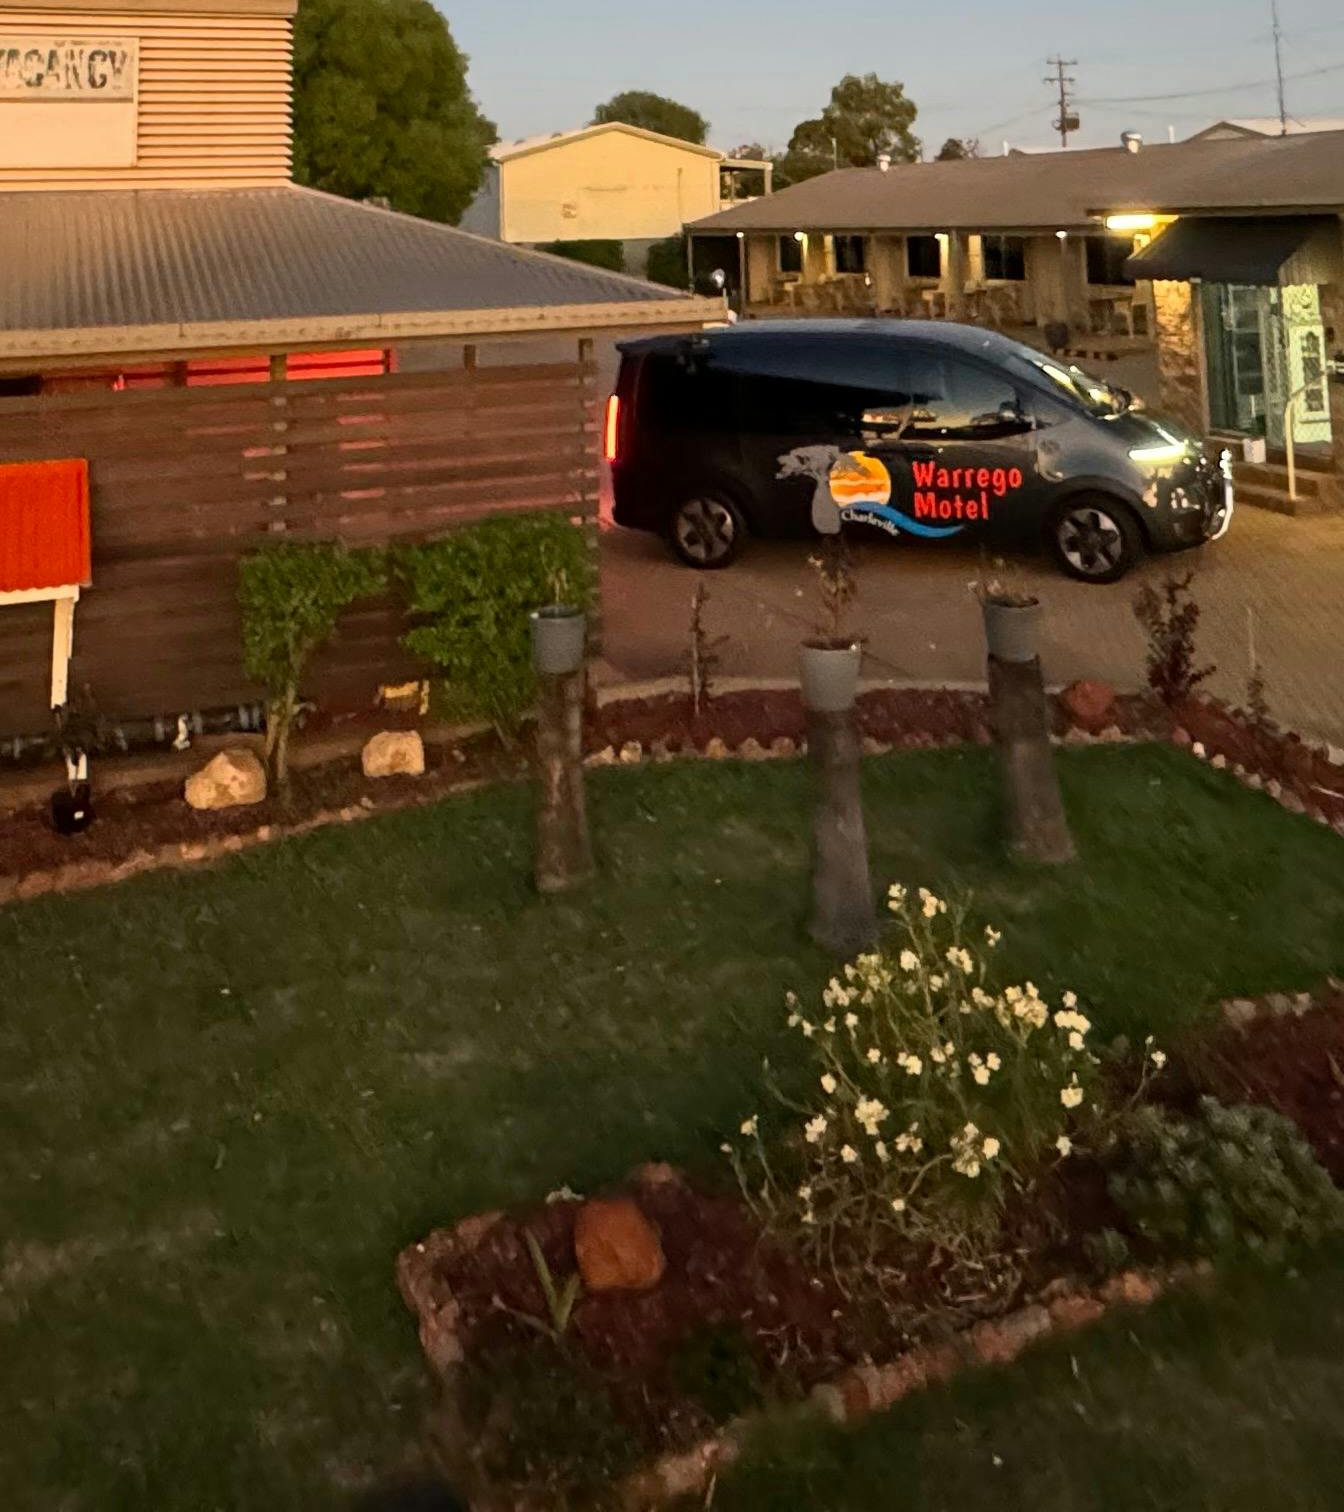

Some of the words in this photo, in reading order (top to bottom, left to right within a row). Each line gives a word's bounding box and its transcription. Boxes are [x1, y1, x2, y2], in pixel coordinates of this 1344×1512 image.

[912, 460, 1023, 496] Warrego
[914, 491, 989, 520] Motel
[841, 509, 900, 537] Charleville
